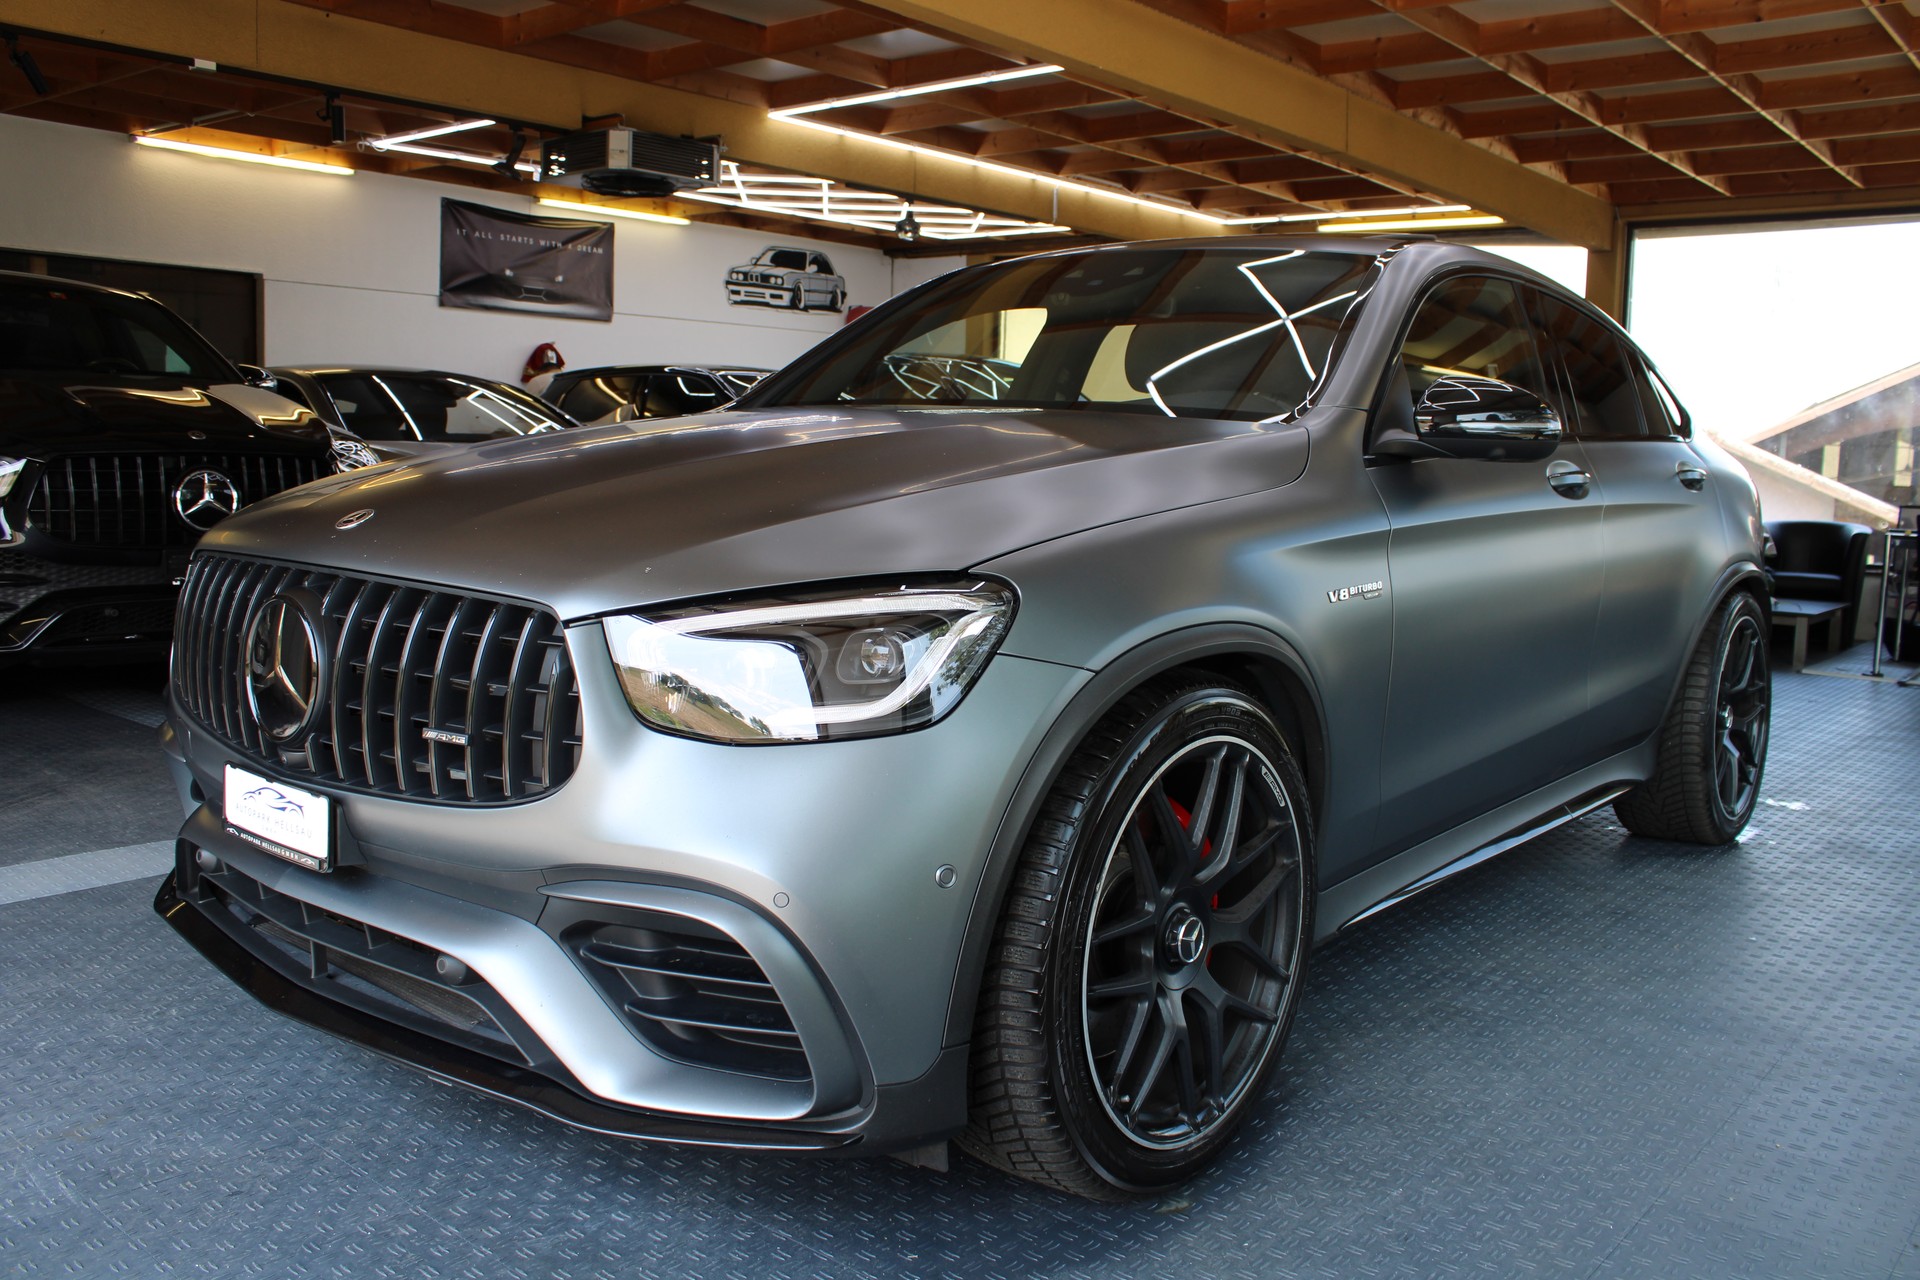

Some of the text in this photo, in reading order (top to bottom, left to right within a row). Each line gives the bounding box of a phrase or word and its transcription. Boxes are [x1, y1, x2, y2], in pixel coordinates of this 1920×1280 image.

[456, 228, 467, 236] IT
[474, 231, 493, 240] ALL
[500, 233, 534, 245] STARTS
[539, 239, 563, 249] WITH
[577, 244, 604, 255] DREAM
[1328, 588, 1350, 603] V8
[1350, 581, 1383, 595] BITURBO
[435, 733, 466, 744] AMG
[1270, 780, 1284, 805] AMG
[236, 802, 270, 824] AUTOPARK
[274, 818, 312, 839] HELLSAU
[240, 832, 261, 846] AUTOPARK
[262, 841, 280, 854] HELLSAU
